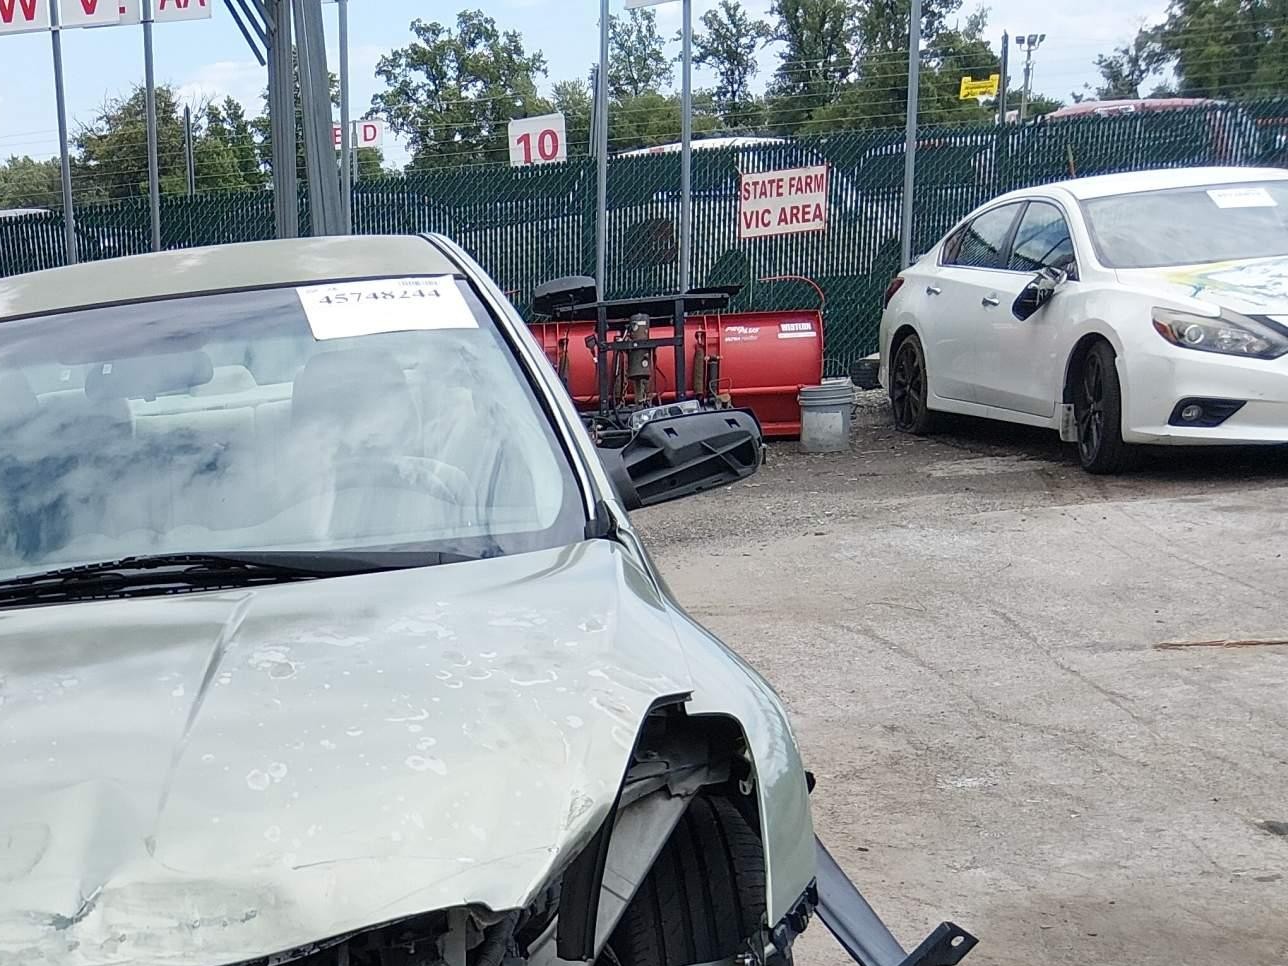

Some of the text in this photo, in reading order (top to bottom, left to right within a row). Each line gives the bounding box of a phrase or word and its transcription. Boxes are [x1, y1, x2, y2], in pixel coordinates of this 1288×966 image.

[363, 124, 377, 141] D
[516, 128, 559, 164] 10
[743, 173, 824, 201] STATE FARM
[743, 203, 824, 230] VIC AREA
[320, 289, 441, 304] 45748244
